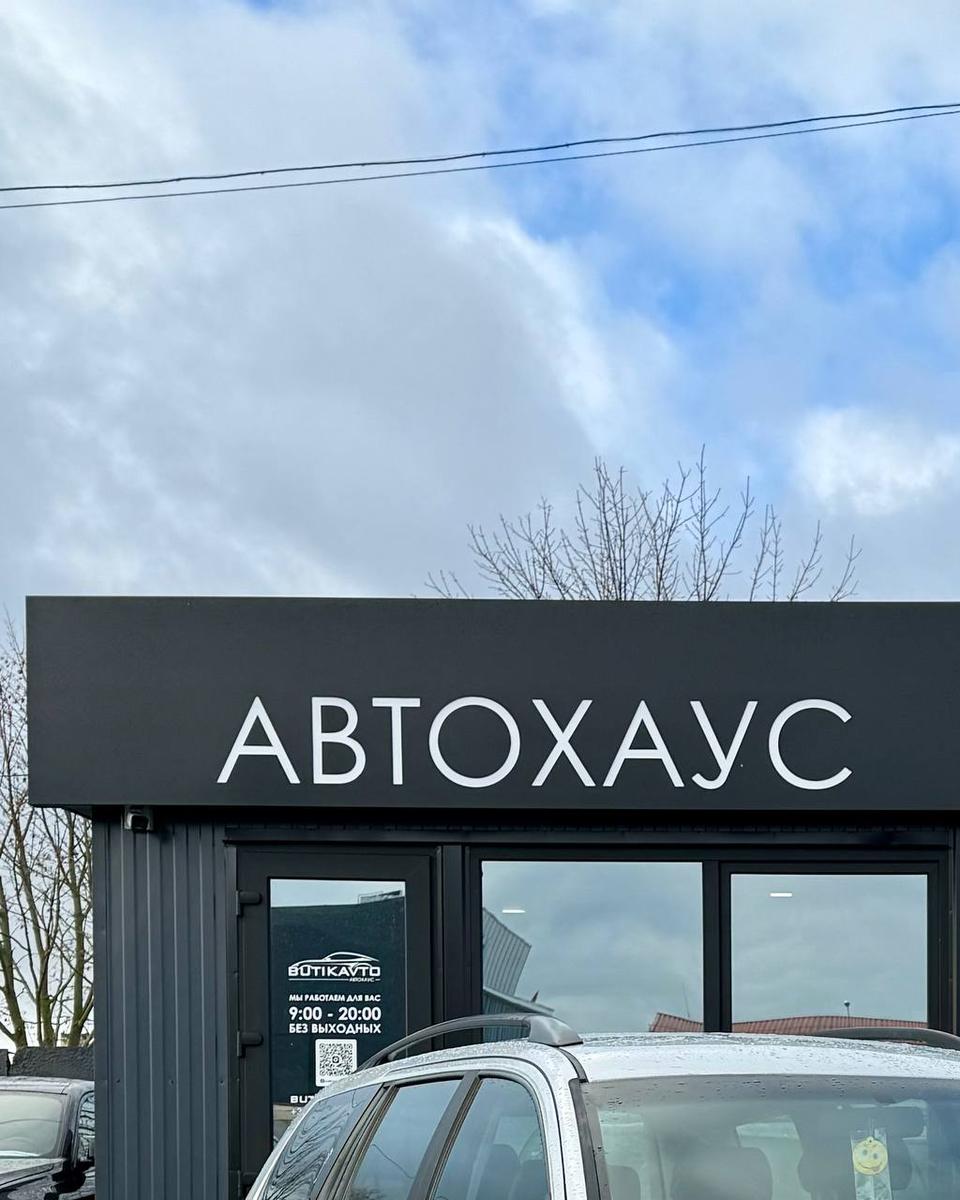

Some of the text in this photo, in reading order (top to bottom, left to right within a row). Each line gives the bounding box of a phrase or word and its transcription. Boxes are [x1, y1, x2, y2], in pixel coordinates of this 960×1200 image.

[217, 696, 853, 790] АВТОХАУС
[288, 966, 381, 977] BUTIKAVTO
[289, 994, 381, 1003] МЫ РАБОТАЕМ ДЛЯ ВАС
[288, 1006, 322, 1021] 9:00
[338, 1006, 381, 1021] 20:00
[288, 1023, 381, 1035] БЕЗ ВЫХОДНЫХ
